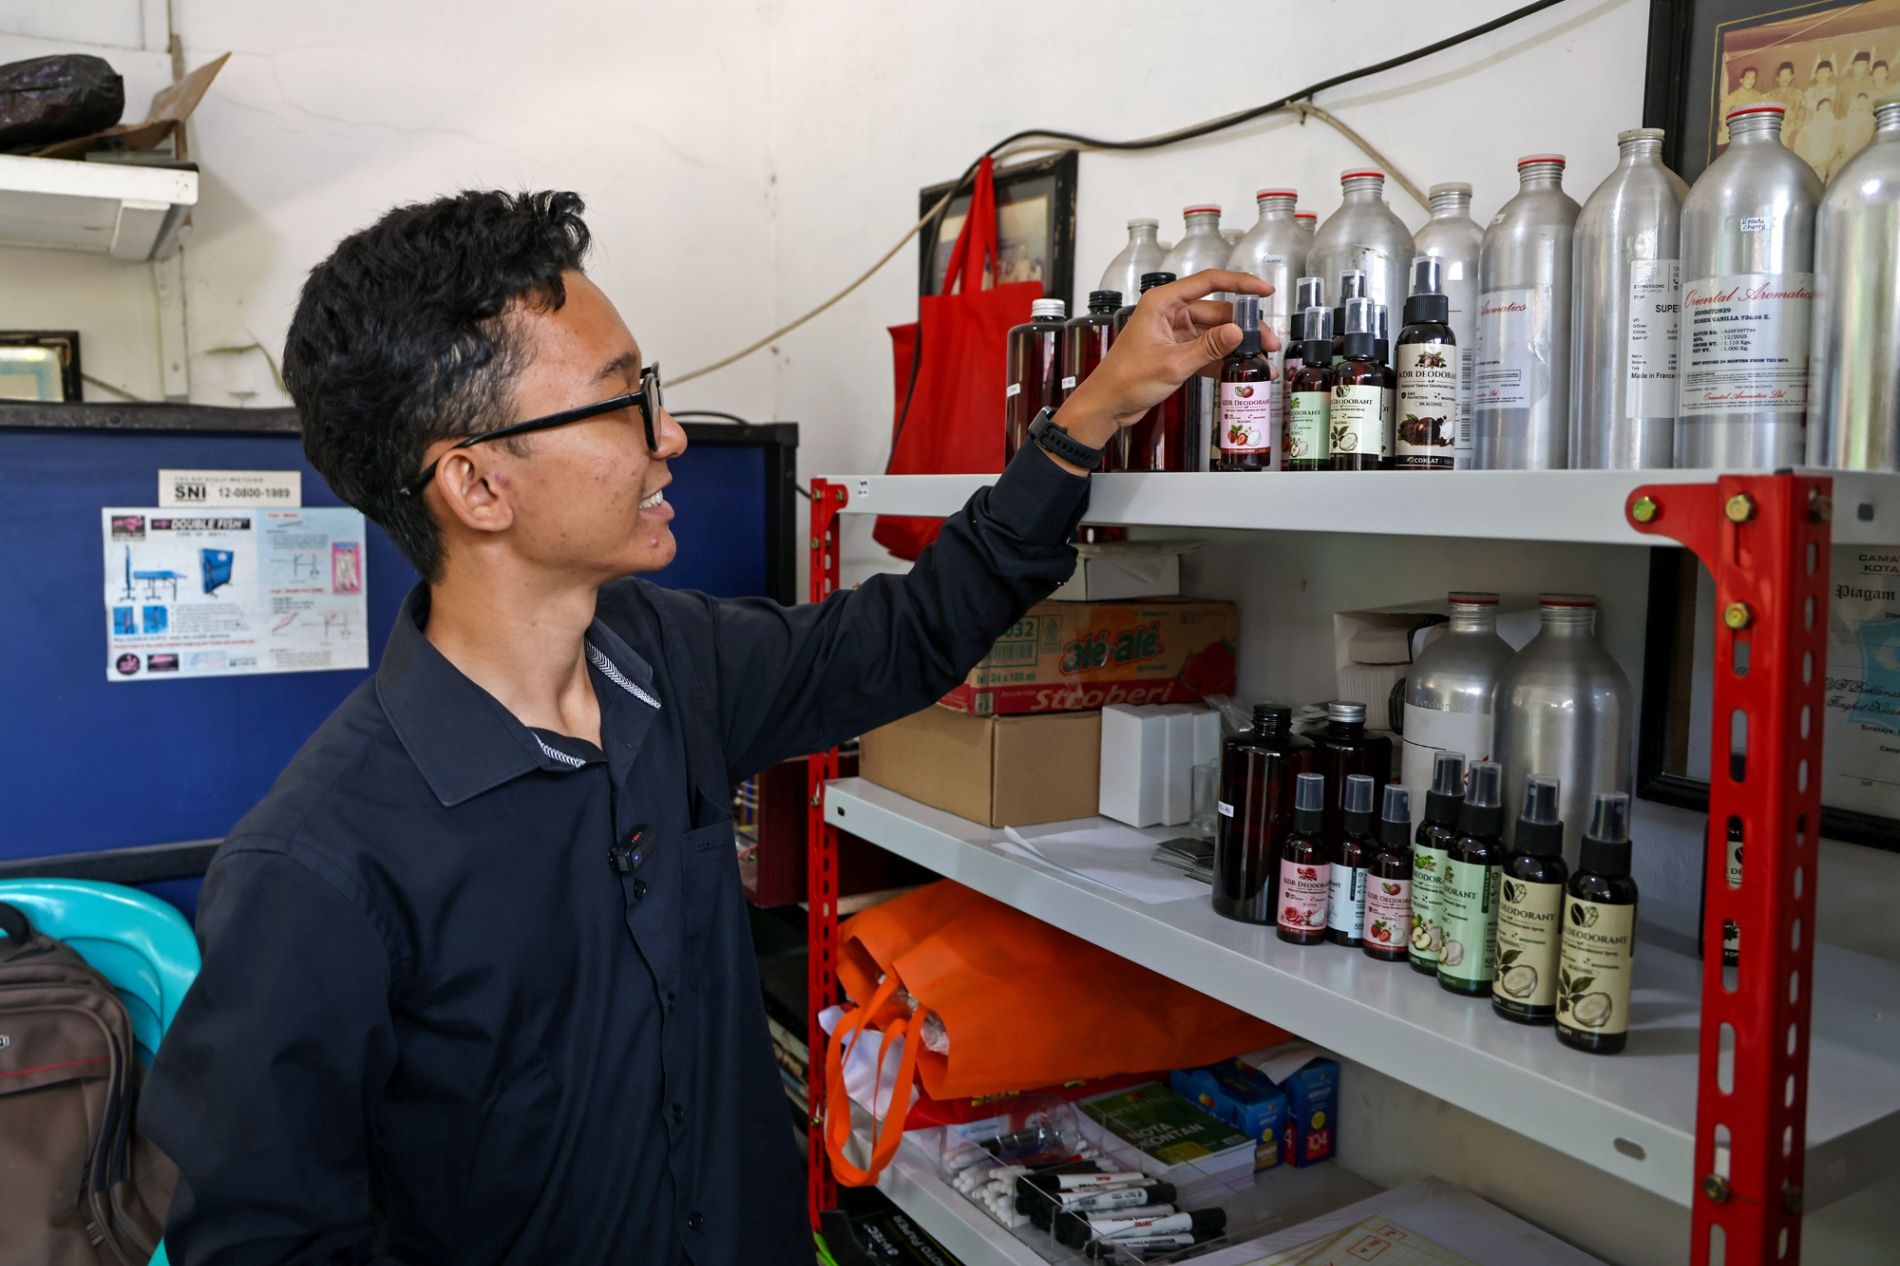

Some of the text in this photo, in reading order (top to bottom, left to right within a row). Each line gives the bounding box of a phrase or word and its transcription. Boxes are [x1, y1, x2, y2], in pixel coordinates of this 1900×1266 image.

[1684, 287, 1740, 309] Oriental
[175, 485, 206, 499] SNI
[171, 519, 214, 529] DOUBLE
[1858, 554, 1900, 562] CAMA
[1864, 564, 1899, 573] KOTA
[1836, 584, 1896, 601] Piagam
[1127, 1122, 1173, 1139] NOTA
[1308, 1132, 1328, 1150] 104
